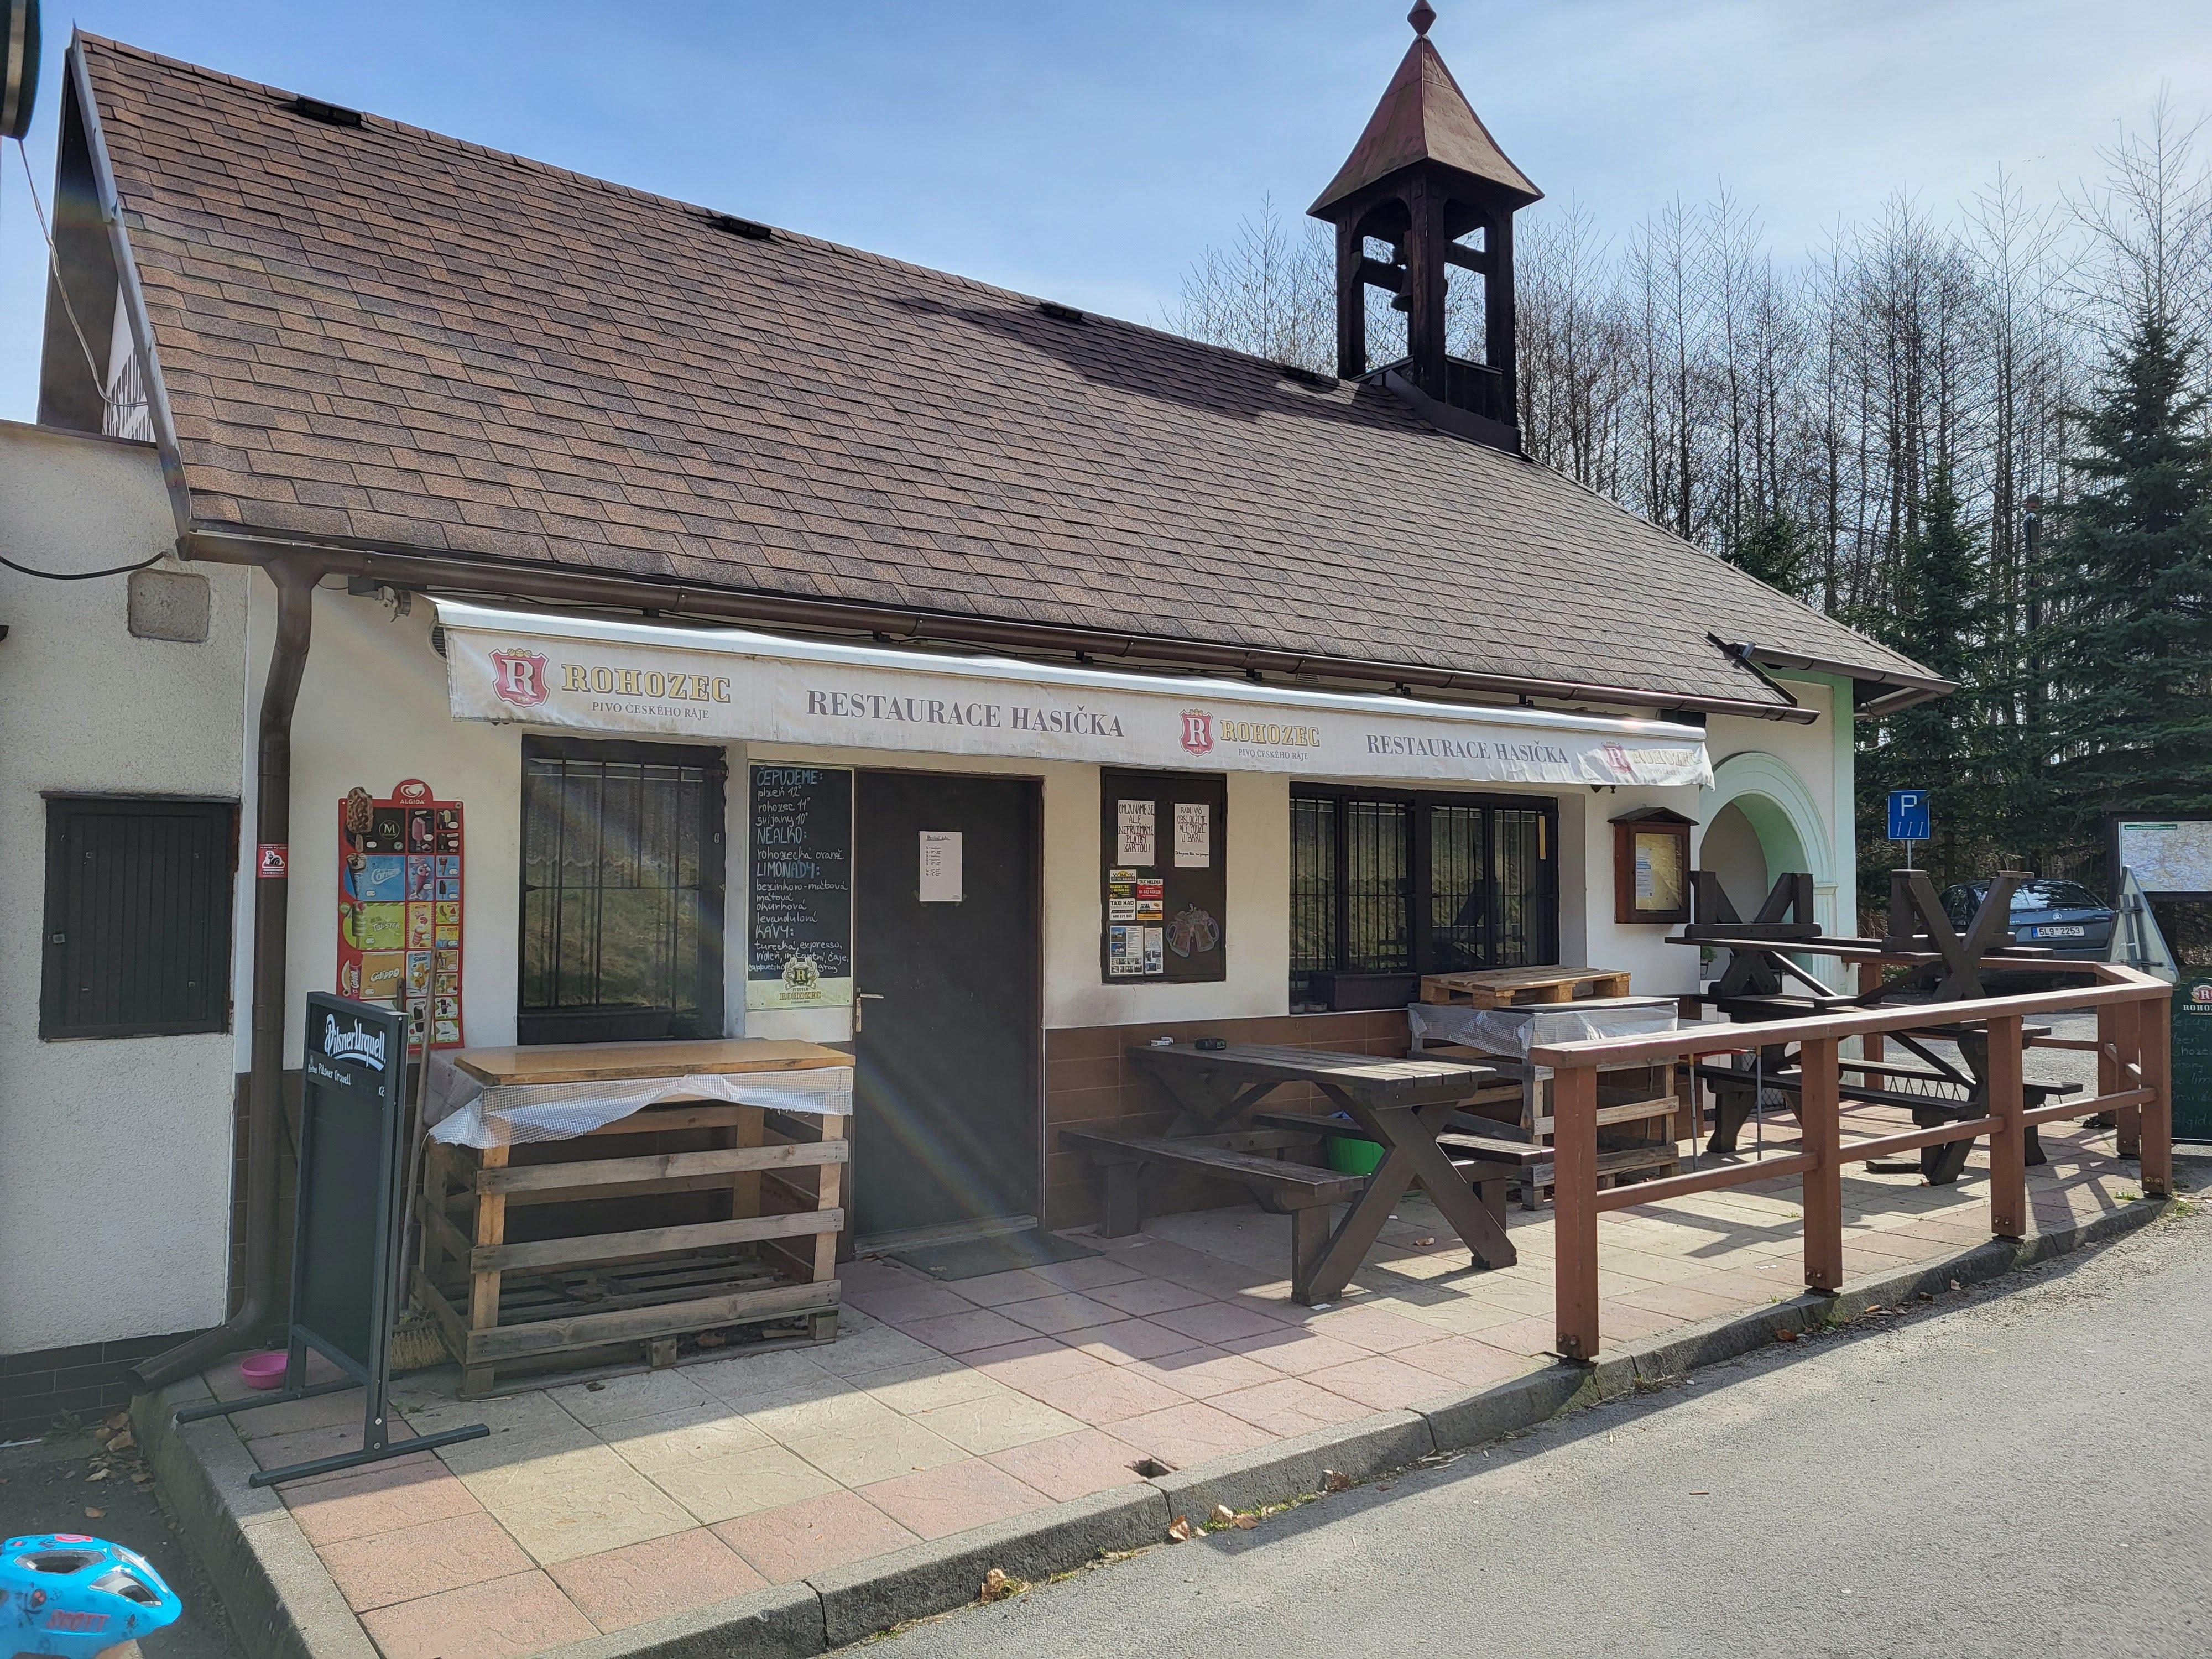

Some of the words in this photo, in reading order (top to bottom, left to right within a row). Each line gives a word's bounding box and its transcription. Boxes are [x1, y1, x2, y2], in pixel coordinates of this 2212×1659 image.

[500, 659, 538, 696] R
[561, 663, 731, 704] ROHOZEC
[592, 701, 622, 714] PIVO
[625, 701, 681, 717] ČESKÉHO
[684, 707, 709, 721] RÁJE
[806, 690, 1001, 728] RESTAURACE
[1010, 704, 1125, 738] HASIČKA
[1186, 717, 1208, 746] R
[1220, 719, 1321, 747] ROHOZEC
[1238, 748, 1255, 758] PIVO
[1256, 749, 1290, 759] ČESKÉHO
[1292, 750, 1308, 761] RÁJE
[1365, 734, 1490, 760] RESTAURACE
[1495, 740, 1569, 764] HASIČKA
[756, 766, 823, 786] ČEPUJEME:
[758, 786, 785, 801] plzeň
[787, 785, 801, 797] 12°
[758, 800, 795, 813] rohozec
[797, 796, 811, 811] 11°
[1180, 805, 1192, 814] RÁDI
[1193, 805, 1203, 814] VÁS
[1901, 795, 1917, 817] P
[755, 814, 794, 828] svijany
[1129, 815, 1142, 824] ALE
[757, 826, 807, 846] NEALKO:
[1179, 824, 1188, 833] ALE
[1190, 824, 1206, 833] POUZE
[1126, 834, 1146, 843] PLATBY
[1187, 833, 1204, 843] BARU
[816, 849, 845, 860] oranž
[1124, 843, 1151, 853] KARTOU!
[756, 891, 794, 902] mátová
[757, 911, 818, 924] levandulová
[755, 923, 794, 940] KÁVY:
[800, 942, 842, 952] expresso,
[828, 951, 849, 966] čaje,
[818, 964, 838, 973] grog
[779, 991, 821, 1000] ROHOZEC
[324, 1014, 356, 1057] Pilsner
[318, 1063, 333, 1078] Pilsner
[334, 1070, 351, 1089] Urquell
[378, 1086, 385, 1097] Kč
